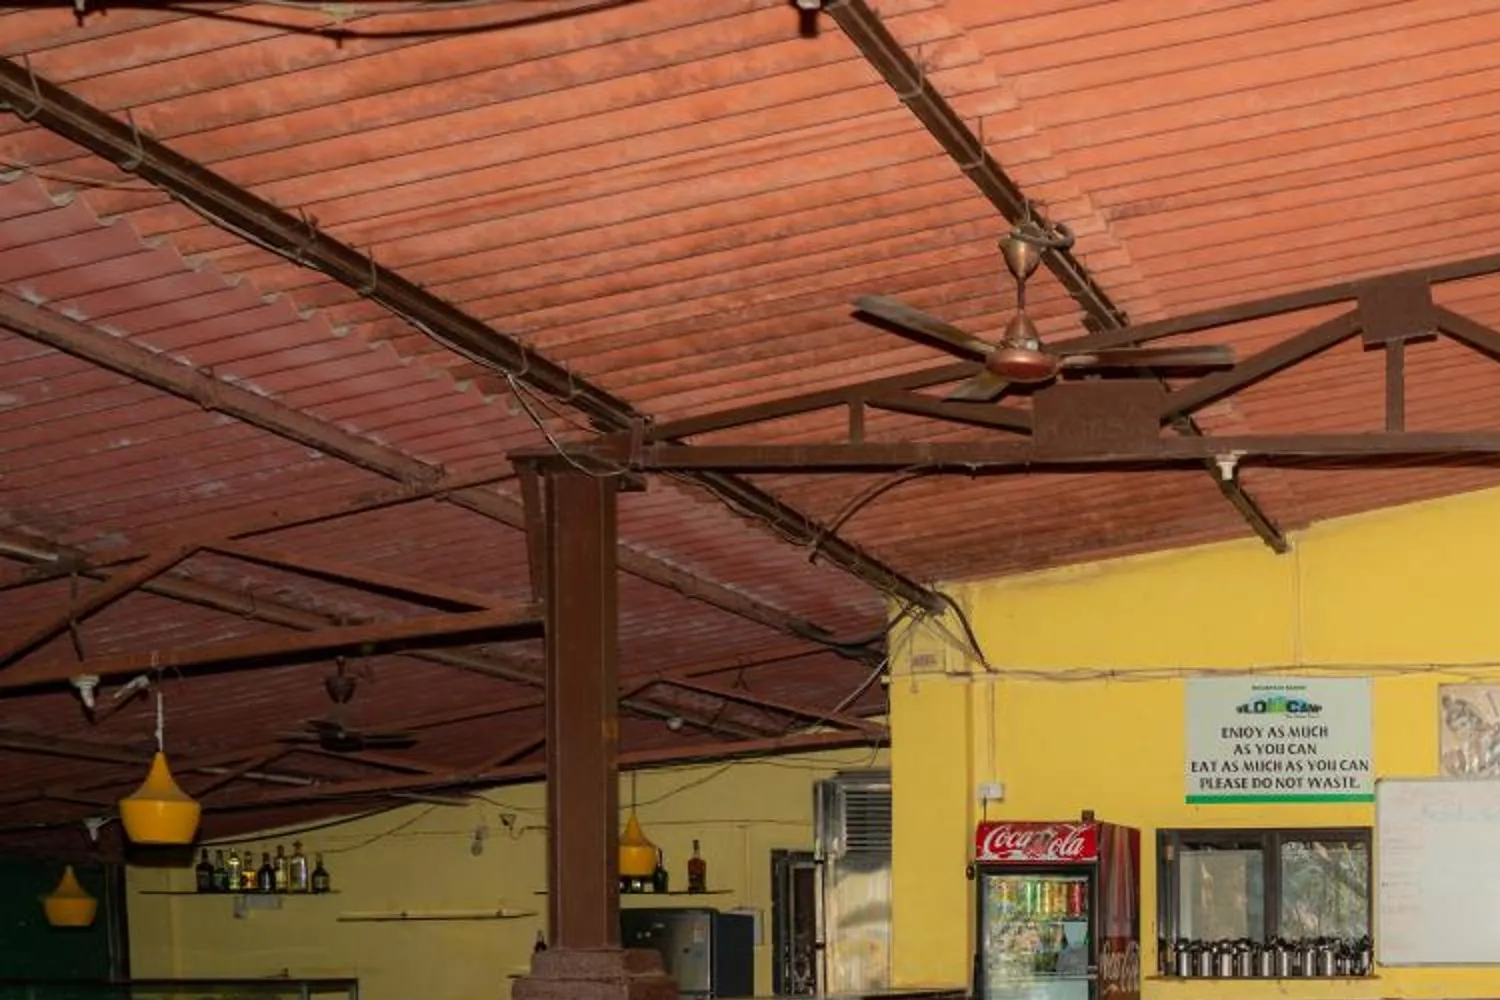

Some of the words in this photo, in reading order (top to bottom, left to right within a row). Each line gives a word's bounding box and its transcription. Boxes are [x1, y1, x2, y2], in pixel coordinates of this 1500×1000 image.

[1221, 727, 1264, 739] ENJOY
[1267, 726, 1285, 738] AS
[1288, 725, 1328, 738] MUCH
[1233, 744, 1251, 755] AS
[1256, 744, 1285, 755] YOU
[1287, 744, 1317, 755] CAN
[1191, 760, 1217, 773] EAT
[1221, 760, 1239, 773] AS
[1242, 760, 1283, 772] MUCH
[1285, 760, 1303, 772] AS
[1306, 760, 1337, 771] YOU
[1339, 759, 1369, 772] CAN
[1200, 777, 1248, 790] PLEASE
[1251, 777, 1274, 789] DO
[1275, 777, 1306, 789] NOT
